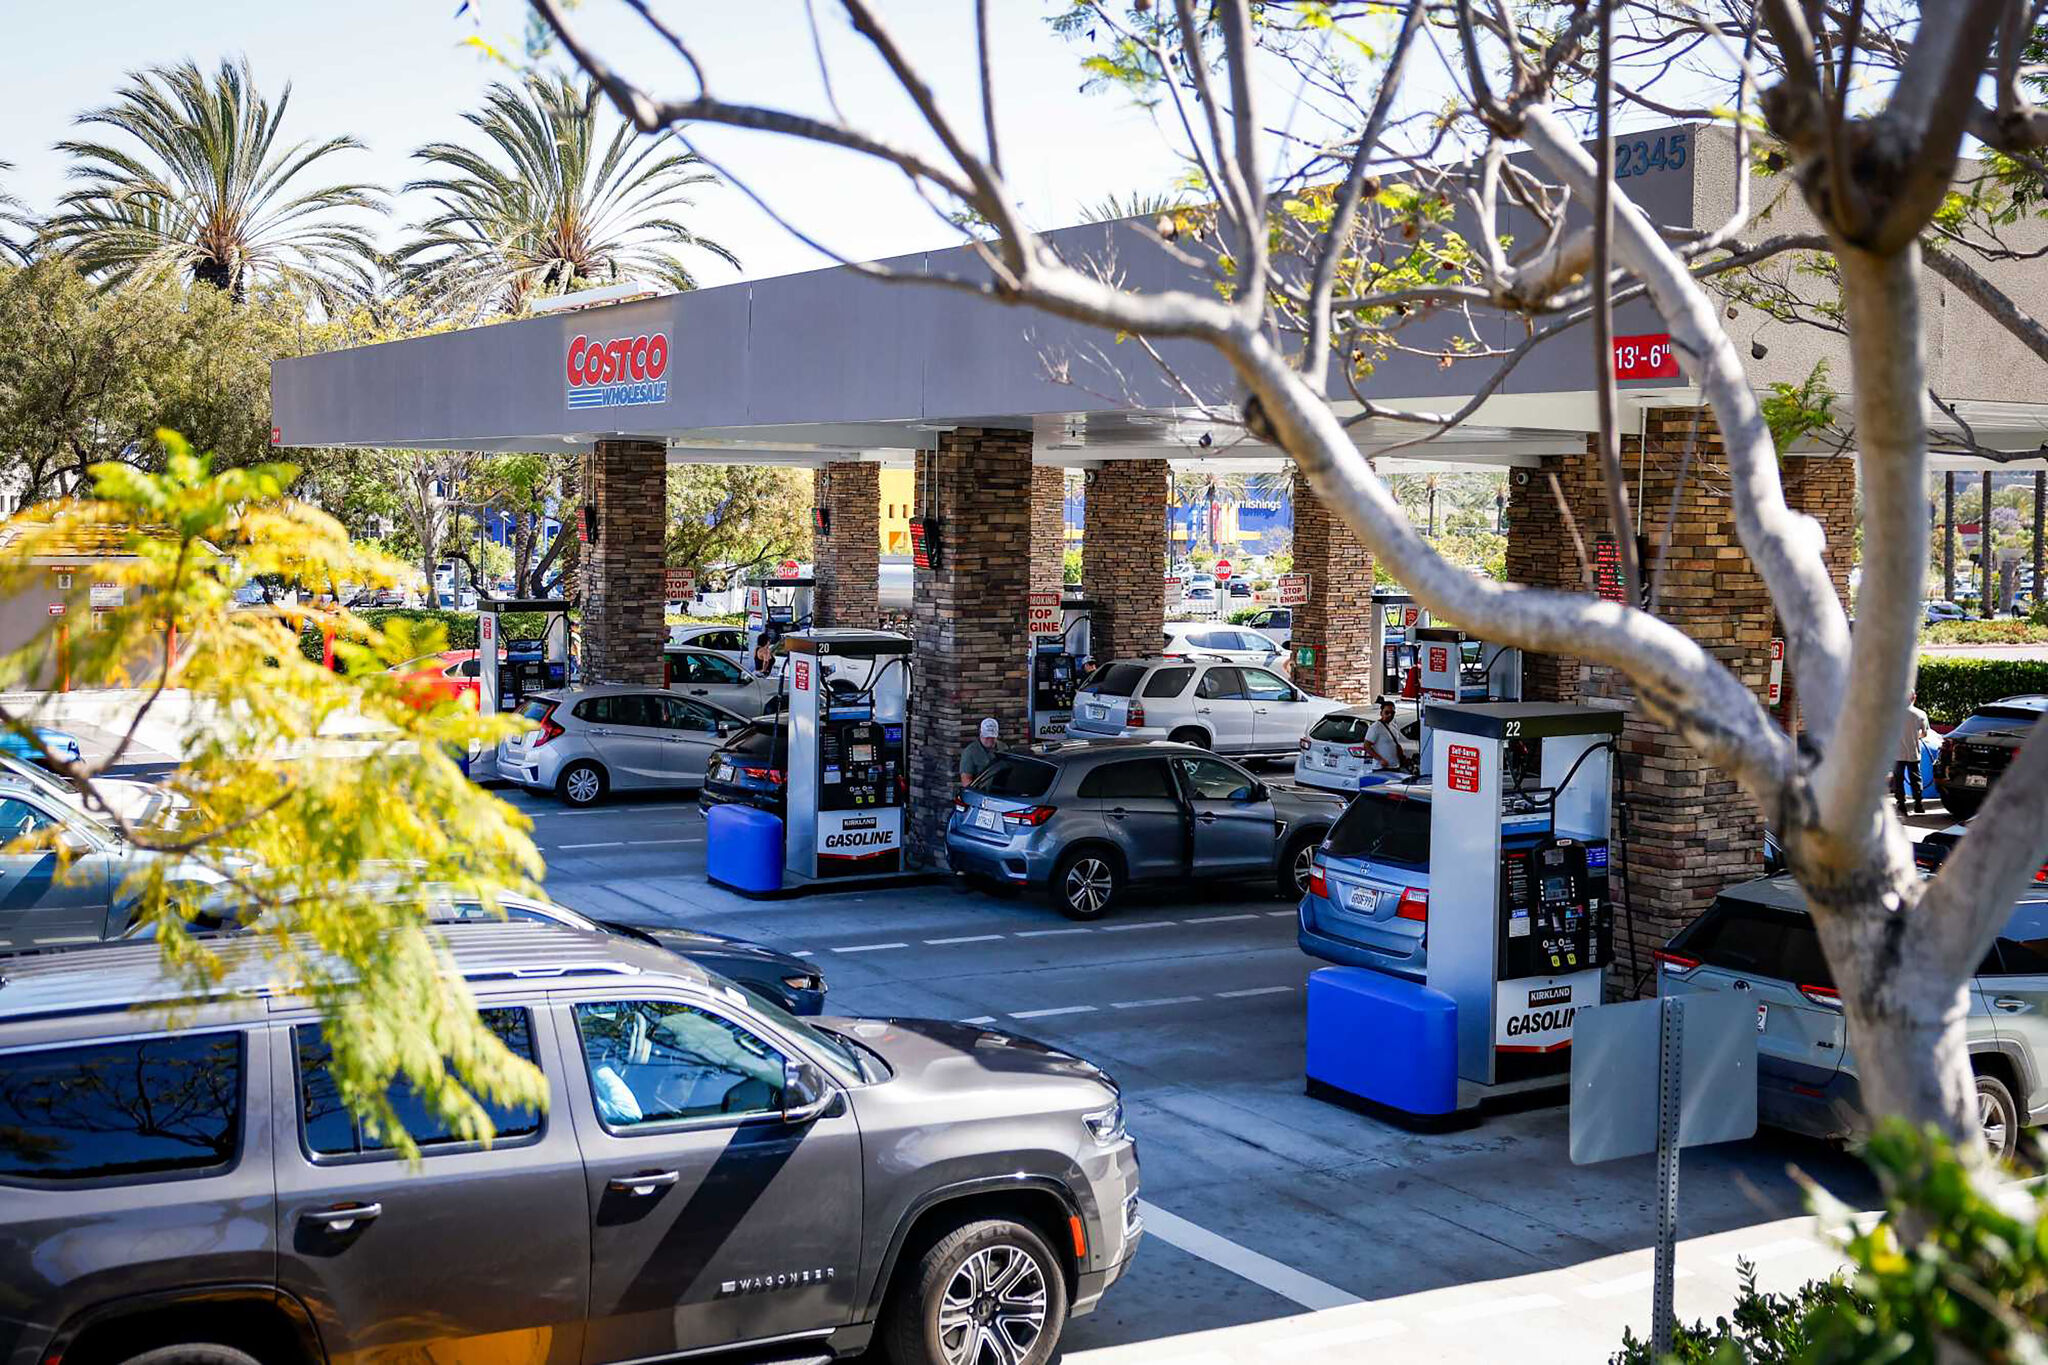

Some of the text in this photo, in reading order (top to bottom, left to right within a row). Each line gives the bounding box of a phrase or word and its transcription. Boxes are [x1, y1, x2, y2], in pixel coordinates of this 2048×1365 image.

[1615, 134, 1687, 178] 2345
[566, 333, 668, 387] COSTCO
[603, 381, 667, 407] WHOLESALE
[779, 567, 798, 576] STOP
[1216, 566, 1232, 574] STOP
[665, 590, 694, 599] NGINE
[1283, 587, 1302, 595] STOP
[1029, 596, 1057, 605] MOKING
[1280, 594, 1307, 604] ENGINE
[1028, 609, 1053, 619] TOP
[1029, 621, 1059, 632] GINE
[818, 642, 830, 653] 20
[1040, 725, 1066, 735] GASOL
[1506, 720, 1520, 737] 22
[844, 819, 876, 828] KIRKLAND
[826, 831, 893, 848] GASOLINE
[1530, 987, 1570, 1001] KIRKLAND
[739, 1267, 835, 1291] WAGONEER
